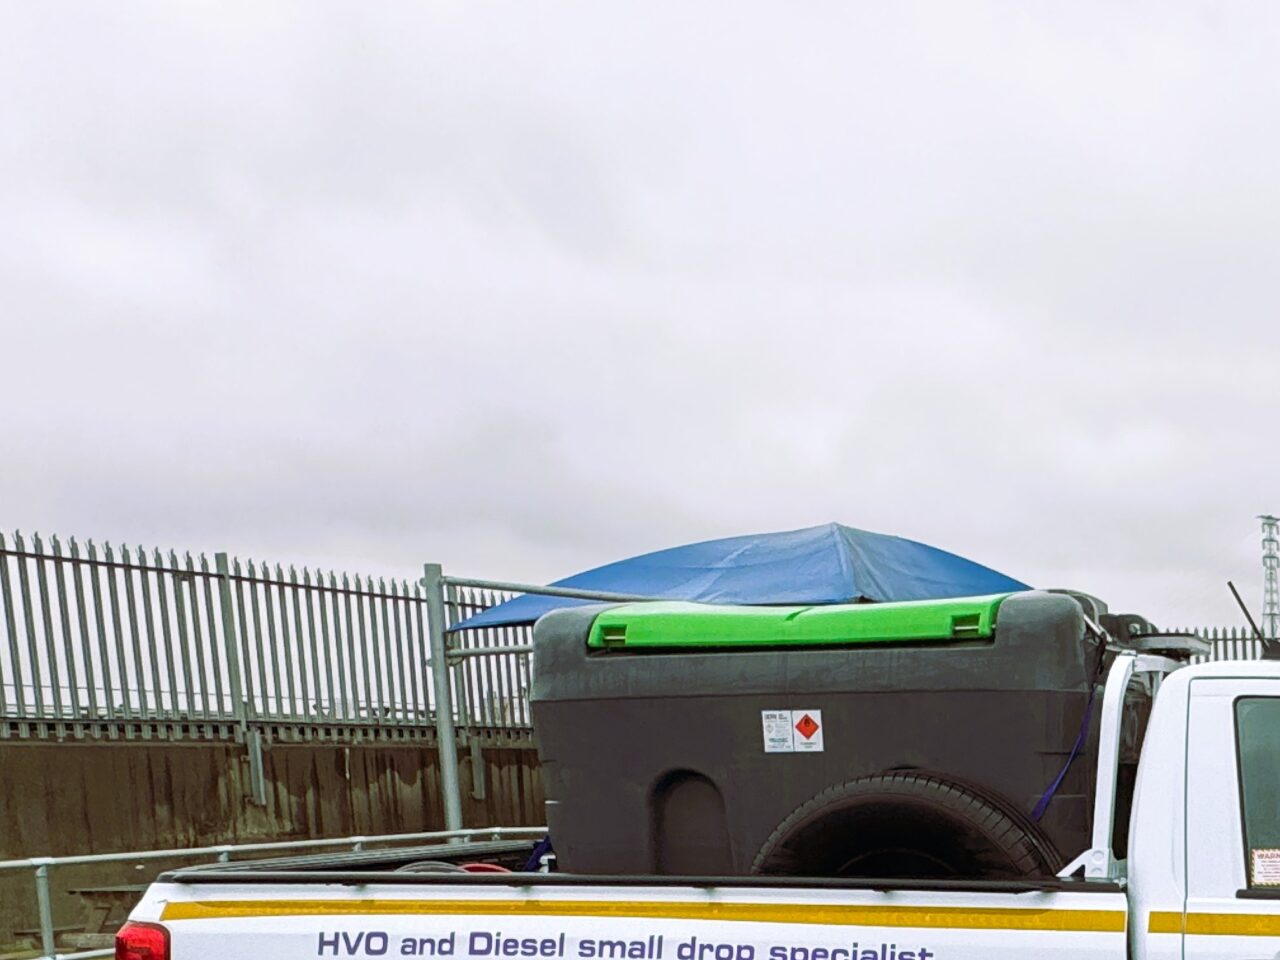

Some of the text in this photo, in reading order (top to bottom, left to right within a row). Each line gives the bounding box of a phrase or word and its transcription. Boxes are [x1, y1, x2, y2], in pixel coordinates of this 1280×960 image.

[317, 931, 389, 956] HVO
[400, 931, 455, 956] and
[468, 932, 565, 957] Diesel
[578, 935, 663, 960] small
